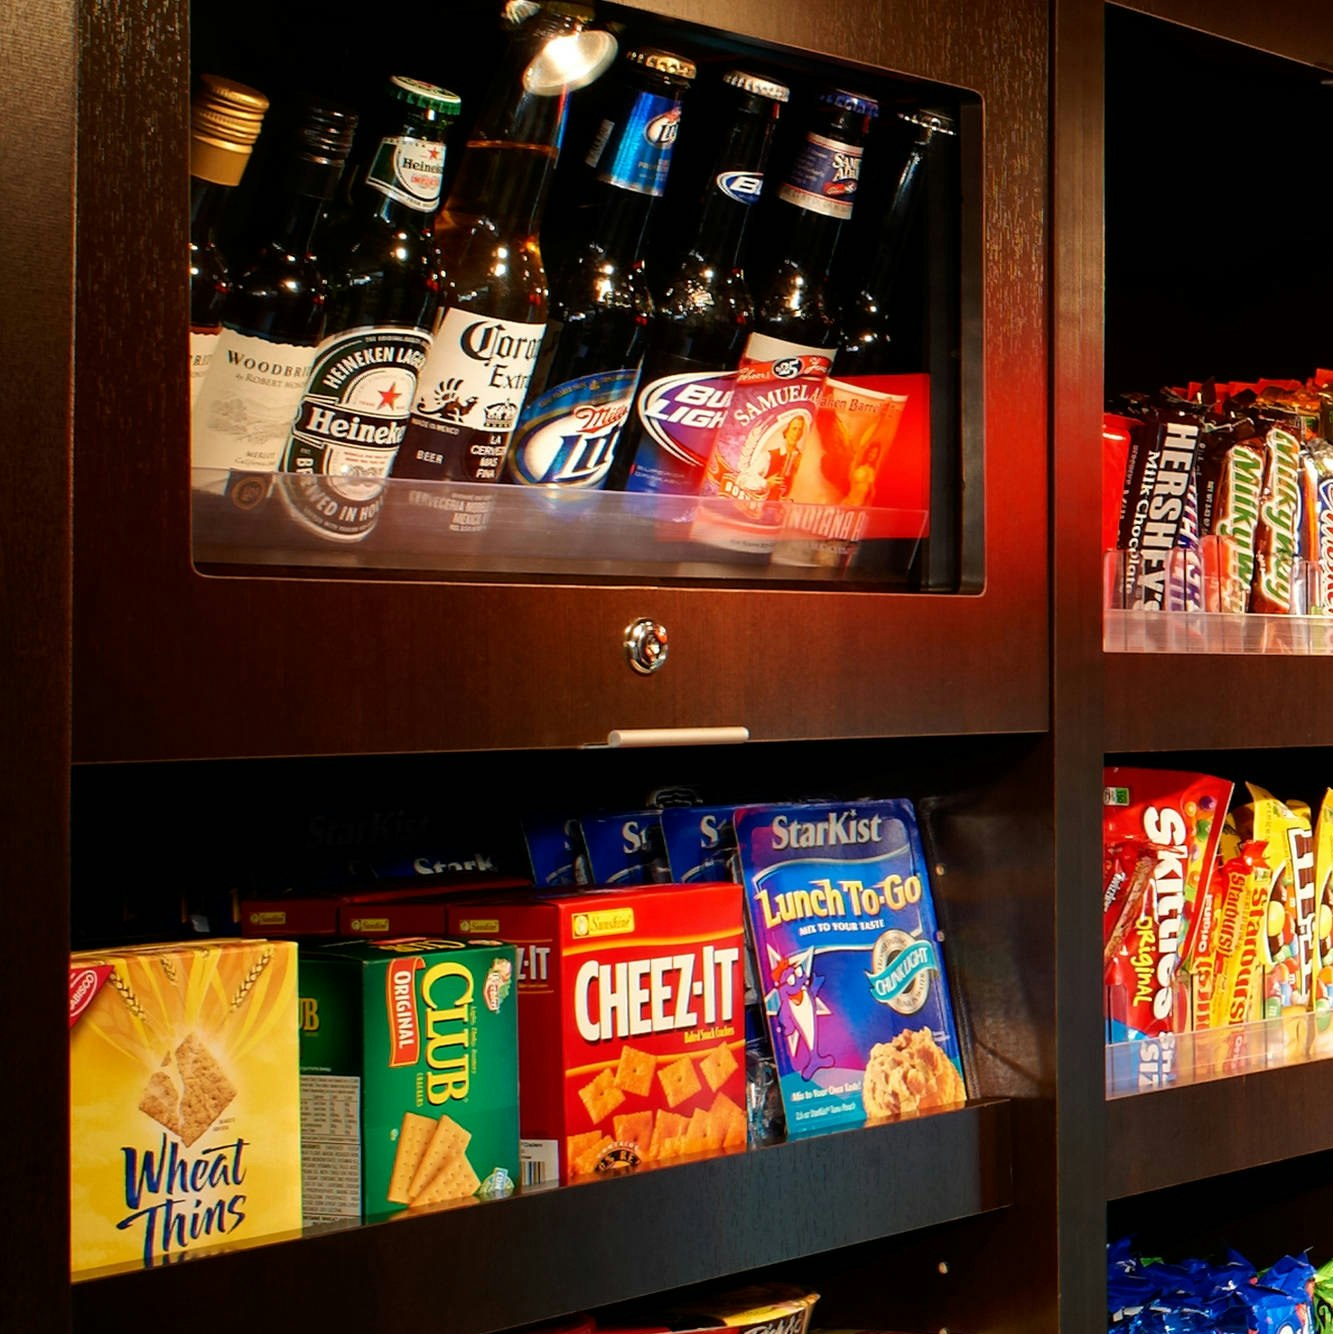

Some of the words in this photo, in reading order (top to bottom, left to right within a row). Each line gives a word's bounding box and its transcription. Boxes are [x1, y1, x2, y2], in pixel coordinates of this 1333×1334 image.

[323, 347, 394, 389] HEINEKEN
[645, 403, 728, 428] LIGH
[733, 384, 808, 428] SAMUEL
[416, 451, 443, 465] BEER
[1138, 451, 1160, 500] Milk
[339, 506, 356, 524] IN
[1132, 422, 1199, 612] HERSHEY'S
[1125, 499, 1151, 595] Chocolate
[771, 807, 882, 851] StarKist
[589, 911, 634, 935] Sunshine
[756, 879, 846, 928] Lunch
[800, 924, 817, 936] MIX
[818, 923, 832, 934] TO
[833, 921, 859, 933] YOUR
[859, 919, 885, 932] TASTE
[1143, 806, 1187, 1021] Skittles
[394, 971, 415, 1049] ORIGINAL
[574, 945, 739, 1043] CHEEZ-IT
[421, 962, 474, 1106] CLUB
[122, 1133, 250, 1210] Wheat
[116, 1195, 247, 1268] Thins
